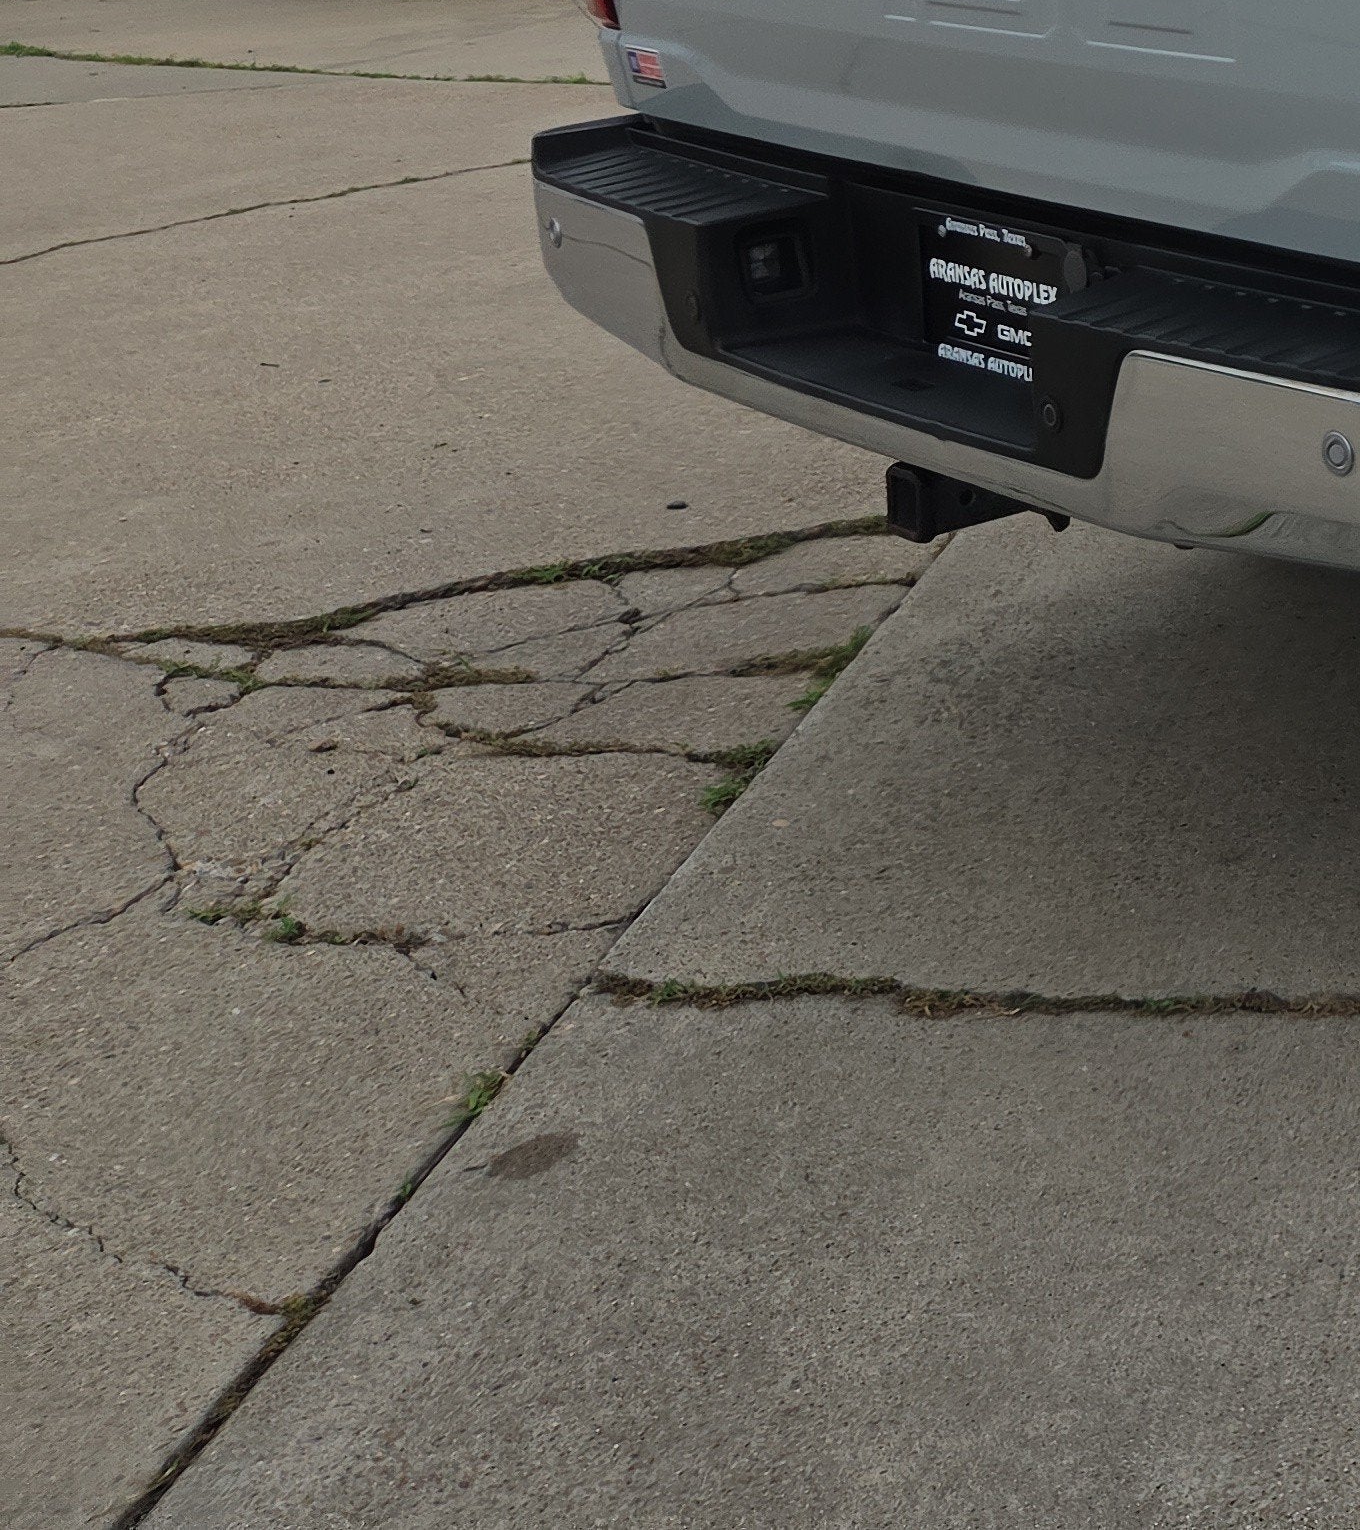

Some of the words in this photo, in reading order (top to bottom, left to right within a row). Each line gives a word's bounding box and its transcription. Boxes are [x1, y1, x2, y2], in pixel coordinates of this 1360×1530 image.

[929, 258, 987, 290] ARANSAS
[989, 272, 1057, 305] AUTOPLEX
[996, 324, 1033, 347] GMC
[937, 342, 986, 369] ARANSAS
[987, 356, 1034, 382] AUTOPL
